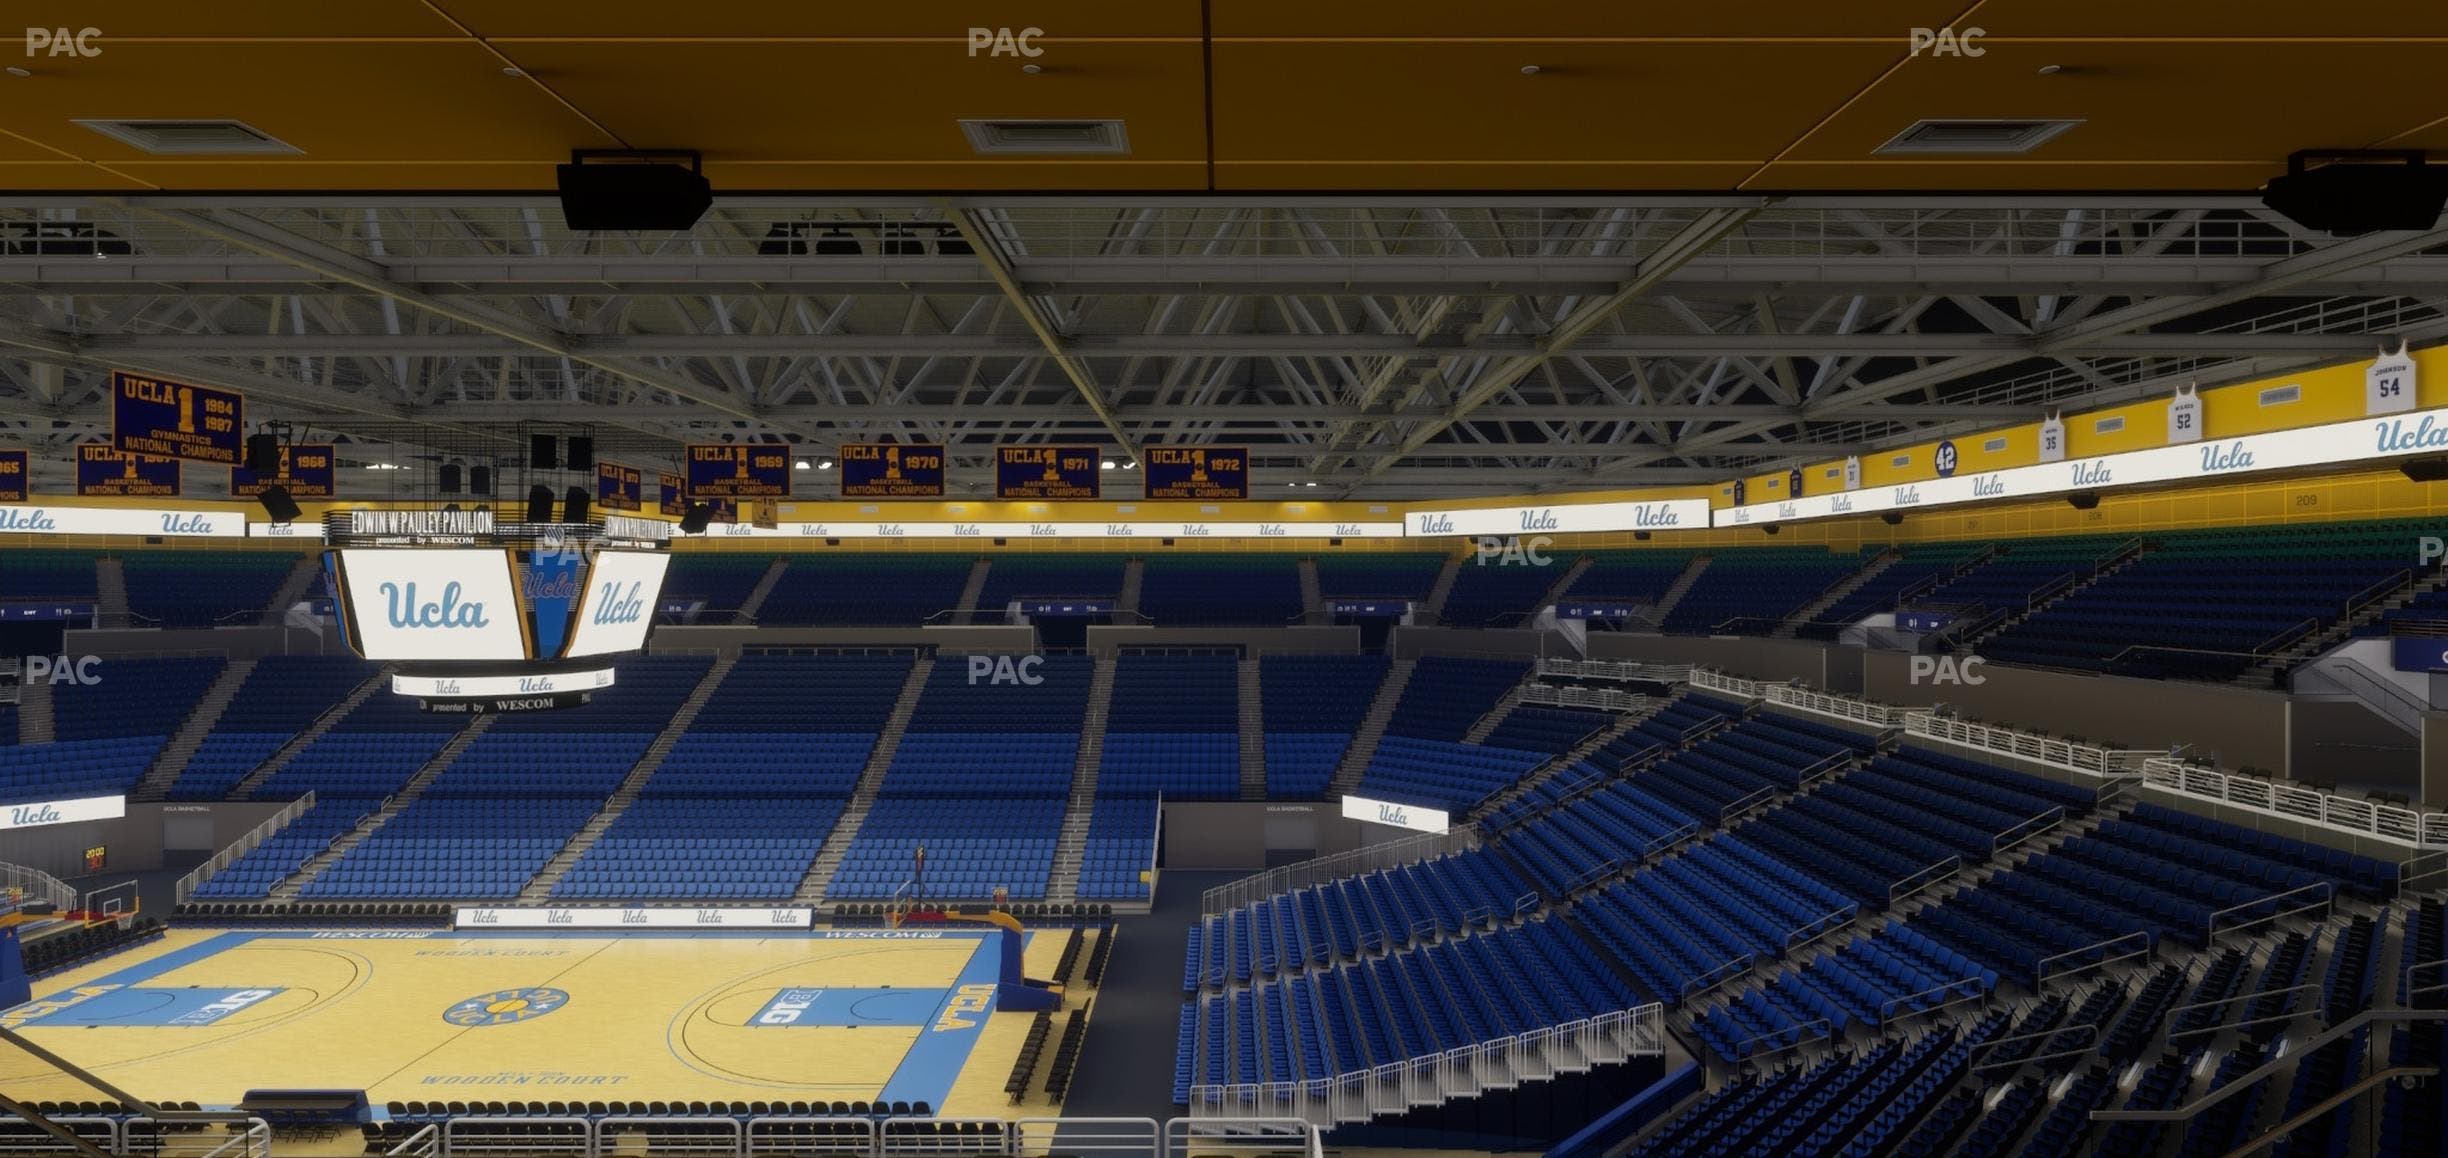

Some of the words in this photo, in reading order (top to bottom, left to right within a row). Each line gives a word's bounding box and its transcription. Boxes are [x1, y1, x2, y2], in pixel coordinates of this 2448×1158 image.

[124, 377, 175, 405] UCLA
[2379, 377, 2400, 398] 54
[205, 398, 233, 415] 1984
[205, 415, 233, 432] 1987
[2177, 413, 2191, 430] 52
[151, 429, 212, 446] GYMNASTICS
[2376, 415, 2448, 452] Ucla
[125, 436, 174, 456] NATIONAL
[180, 441, 233, 462] CHAMPIONS
[2045, 436, 2057, 450] 35
[694, 446, 733, 461] UCLA
[843, 447, 880, 460] UCLA
[1004, 449, 1043, 463] UCLA
[1151, 449, 1191, 464] UCLA
[1935, 447, 1956, 470] 42
[2200, 441, 2255, 472] Ucla
[754, 456, 783, 468] 1969
[905, 455, 939, 469] 1970
[1062, 457, 1089, 471] 1971
[1211, 458, 1240, 471] 1972
[2072, 460, 2112, 486] Ucla
[85, 485, 121, 495] NATIONAL
[128, 485, 172, 495] CHAMPIONS
[695, 485, 734, 495] NATIONAL
[736, 485, 782, 495] CHAMPIONS
[846, 485, 887, 495] NATIONAL
[888, 485, 939, 495] CHAMPIONS
[1004, 487, 1043, 497] NATIONAL
[1047, 487, 1092, 497] CHAMPIONS
[1152, 488, 1191, 498] NATIONAL
[1195, 488, 1240, 498] CHAMPIONS
[1973, 475, 2005, 497] Ucla
[1895, 486, 1920, 506] Ucla
[2296, 495, 2317, 507] 209
[0, 509, 55, 530] Ucla
[1520, 509, 1558, 531] Ucla
[1635, 503, 1679, 527] Ucla
[161, 513, 213, 534] Ucla
[352, 511, 386, 534] EDWIN
[388, 511, 399, 534] W
[401, 511, 441, 534] PAULEY
[442, 511, 493, 534] PAVILION
[1421, 514, 1454, 534] Ucla
[800, 524, 827, 536] Ucla
[878, 524, 904, 536] Ucla
[954, 524, 980, 536] Ucla
[1029, 524, 1056, 536] Ucla
[1106, 524, 1133, 536] Ucla
[1183, 524, 1209, 536] Ucla
[1259, 524, 1286, 536] Ucla
[1336, 524, 1362, 536] Ucla
[417, 536, 426, 546] by
[431, 536, 475, 545] WESCOM
[380, 581, 489, 629] Ucla
[594, 581, 644, 625] Ucla
[435, 679, 461, 695] Ucla
[519, 678, 554, 693] Ucla
[472, 702, 485, 714] by
[496, 697, 554, 711] WESCOM
[11, 805, 60, 826] Ucla
[1378, 804, 1408, 826] Ucla
[473, 910, 498, 924] Ucla
[547, 910, 573, 924] Ucla
[622, 910, 648, 924] Ucla
[697, 910, 723, 924] Ucla
[771, 910, 797, 924] Ucla
[825, 931, 919, 939] WESCOM
[932, 983, 998, 1032] UCLA
[420, 1075, 530, 1085] WOODEN
[537, 1075, 629, 1085] COURT
